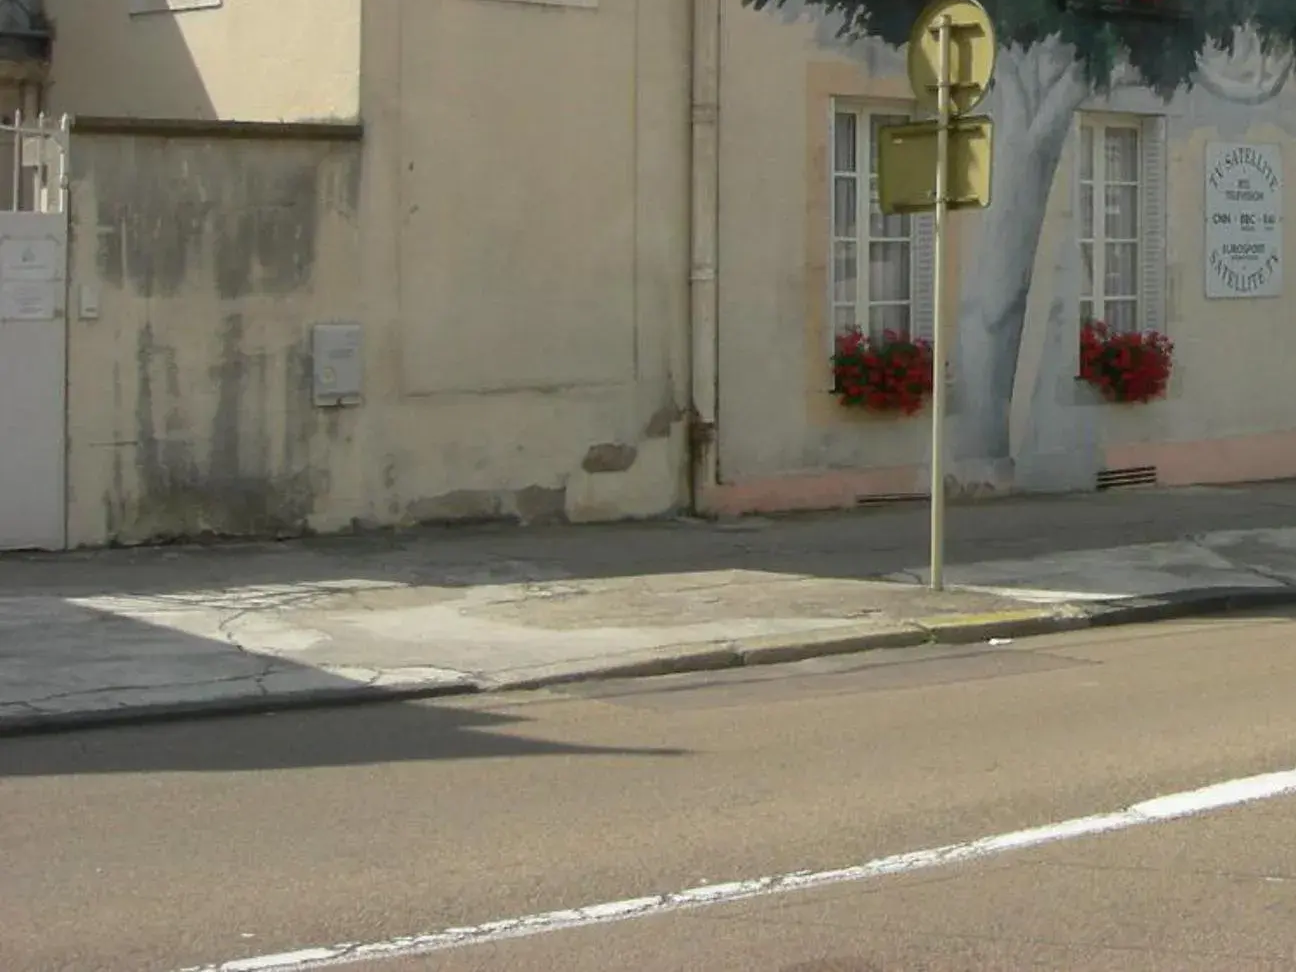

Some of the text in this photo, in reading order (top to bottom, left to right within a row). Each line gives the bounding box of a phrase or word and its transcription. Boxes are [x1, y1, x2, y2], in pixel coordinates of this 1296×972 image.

[1225, 147, 1279, 193] SATELLITE
[1212, 212, 1231, 224] CNN
[1210, 248, 1265, 291] SATELLITE
